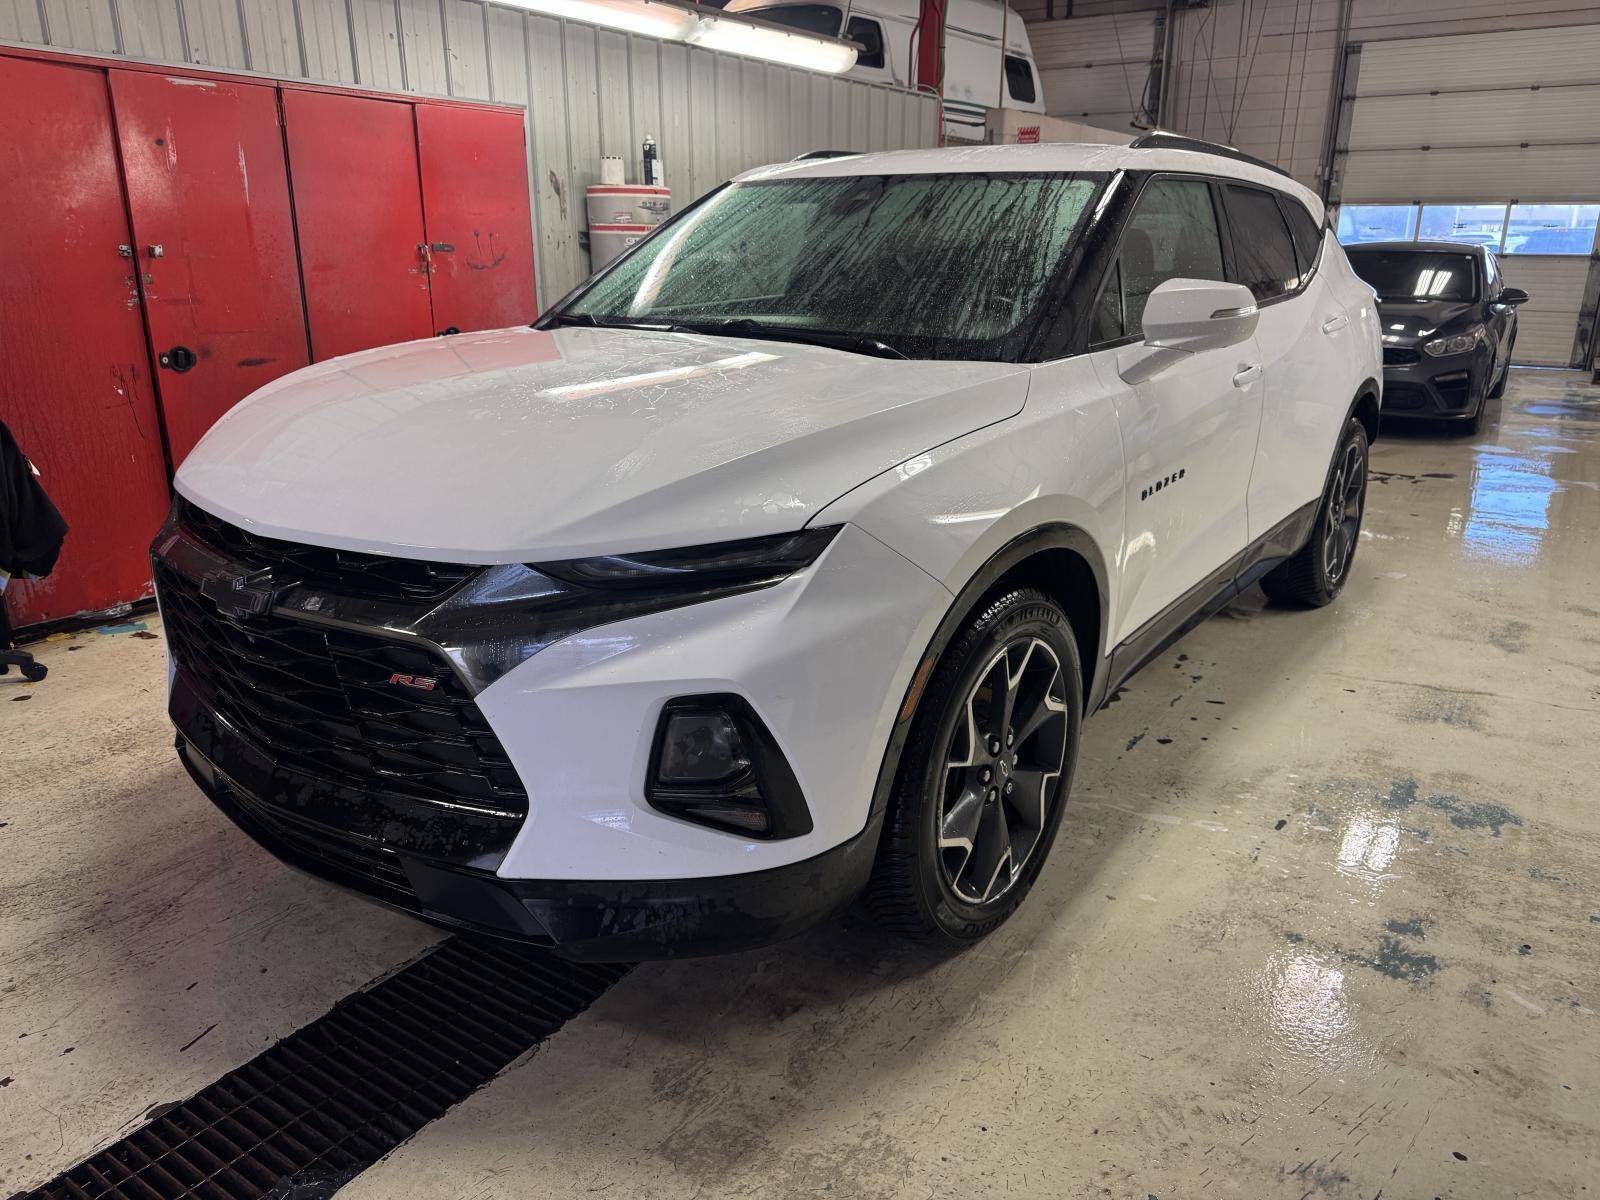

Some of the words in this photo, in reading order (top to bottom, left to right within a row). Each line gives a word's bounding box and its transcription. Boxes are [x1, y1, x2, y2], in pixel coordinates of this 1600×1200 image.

[1141, 469, 1186, 501] BLAZER
[1013, 607, 1060, 624] MICHELIN
[389, 673, 437, 690] RS
